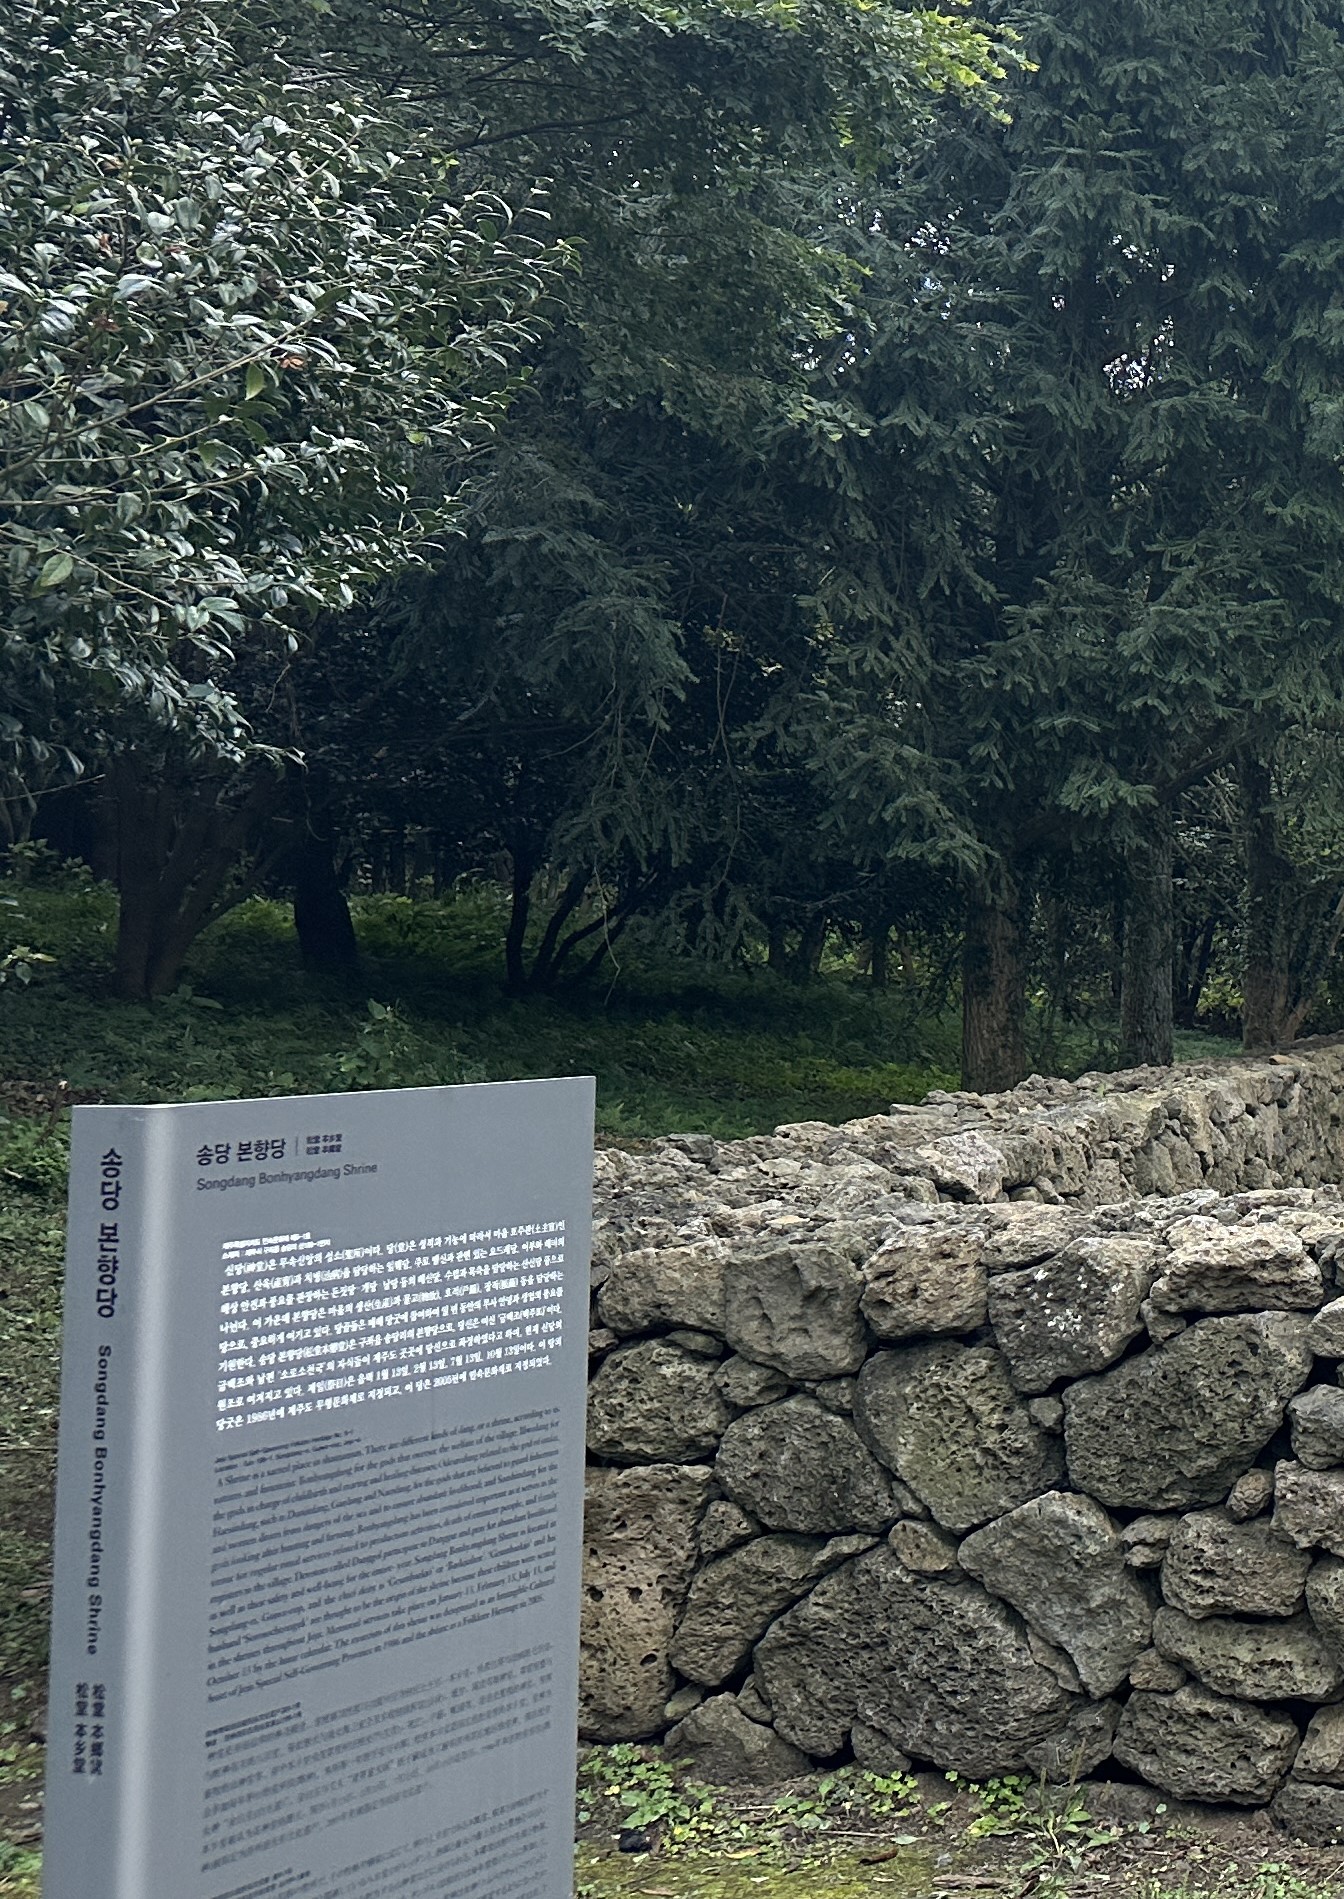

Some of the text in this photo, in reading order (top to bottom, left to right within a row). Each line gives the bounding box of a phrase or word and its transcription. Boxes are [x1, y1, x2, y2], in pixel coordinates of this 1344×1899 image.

[196, 1138, 287, 1166] 송당 본향당
[196, 1163, 378, 1191] Songdang Bonhyangdang Shrine
[96, 1147, 123, 1319] 송당 본향당
[86, 1345, 112, 1655] Songdang Bonhyangdang Shrine
